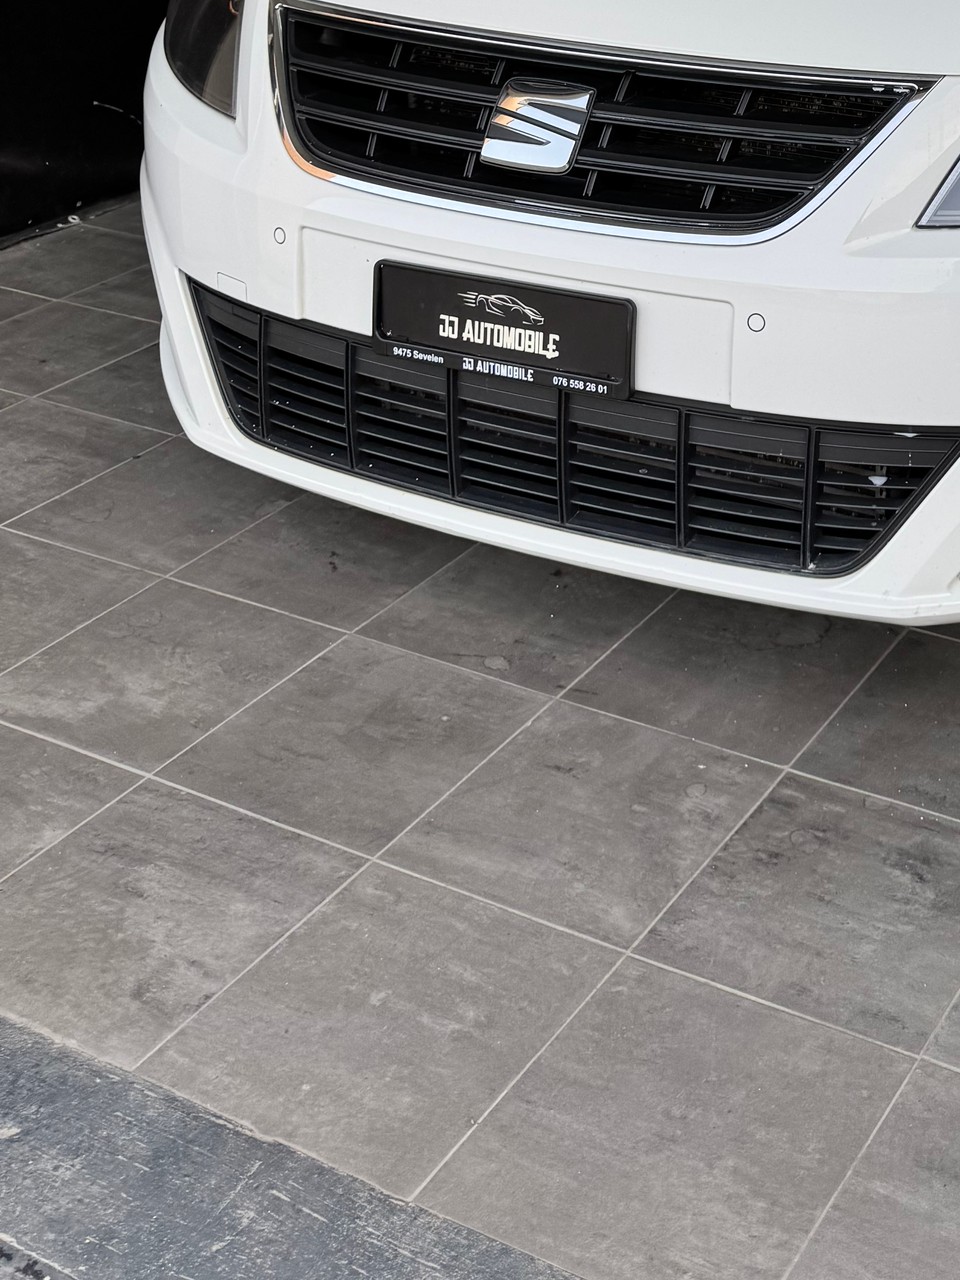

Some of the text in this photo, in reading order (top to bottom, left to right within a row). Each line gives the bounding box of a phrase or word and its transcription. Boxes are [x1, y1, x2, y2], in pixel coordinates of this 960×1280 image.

[439, 314, 560, 359] JJ AUTOMOBILE
[393, 346, 444, 364] 9475 Sevelen
[462, 357, 534, 382] JJ AUTOMOBILE
[552, 376, 608, 394] 076 558 26 01
